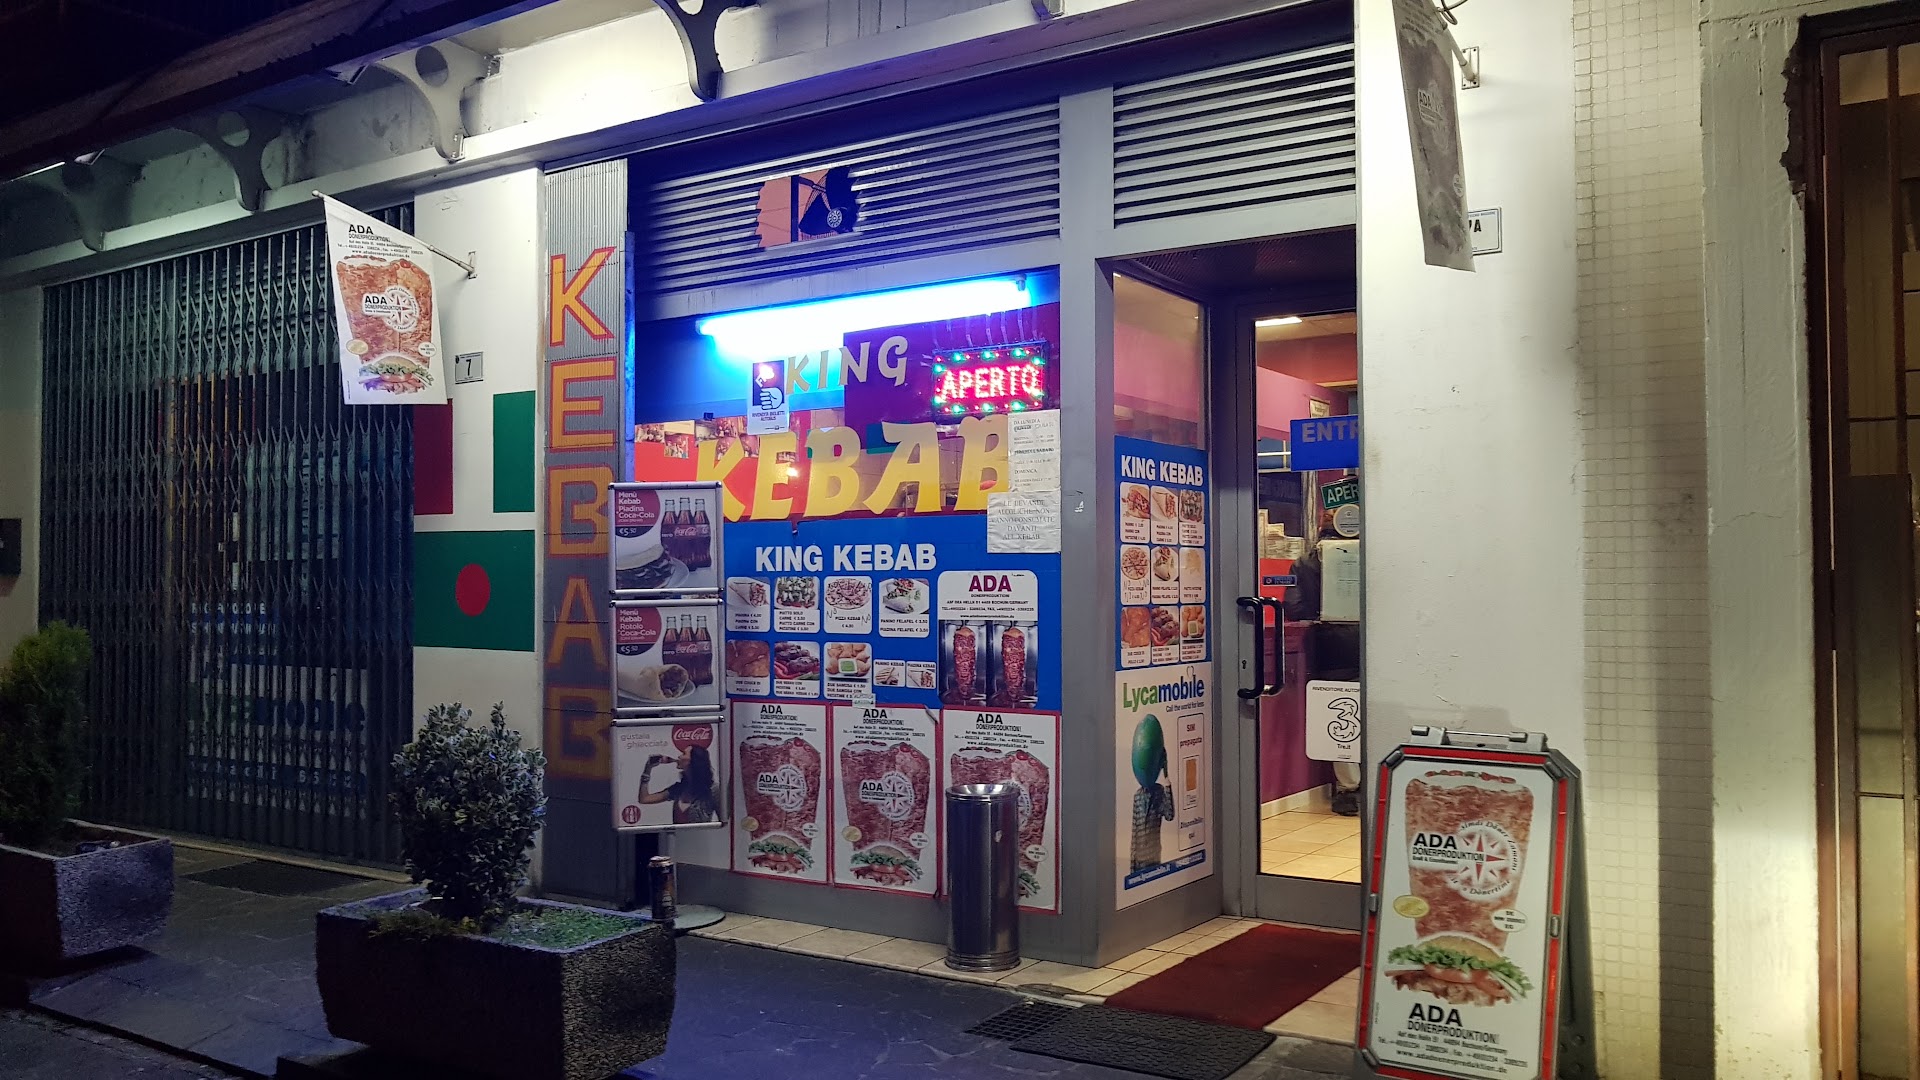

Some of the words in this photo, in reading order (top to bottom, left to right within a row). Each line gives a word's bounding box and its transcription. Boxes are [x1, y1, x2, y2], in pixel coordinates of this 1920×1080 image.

[348, 224, 374, 235] ADA
[365, 295, 387, 305] ADA
[465, 358, 472, 376] 7
[786, 336, 909, 395] KING
[937, 363, 1041, 400] APERTO
[697, 414, 1009, 522] KEBAB
[1121, 454, 1156, 481] KING
[1160, 460, 1203, 486] KEBAB
[755, 544, 823, 572] KING
[833, 543, 936, 571] KEBAB
[968, 574, 1012, 592] ADA
[1123, 674, 1204, 713] Lycamobile
[760, 704, 783, 714] ADA
[863, 708, 888, 719] ADA
[976, 713, 1003, 724] ADA
[673, 727, 712, 741] Coca-Cola
[759, 774, 778, 783] ADA
[861, 782, 883, 791] ADA
[1413, 833, 1458, 850] ADA
[1408, 1002, 1463, 1027] ADA
